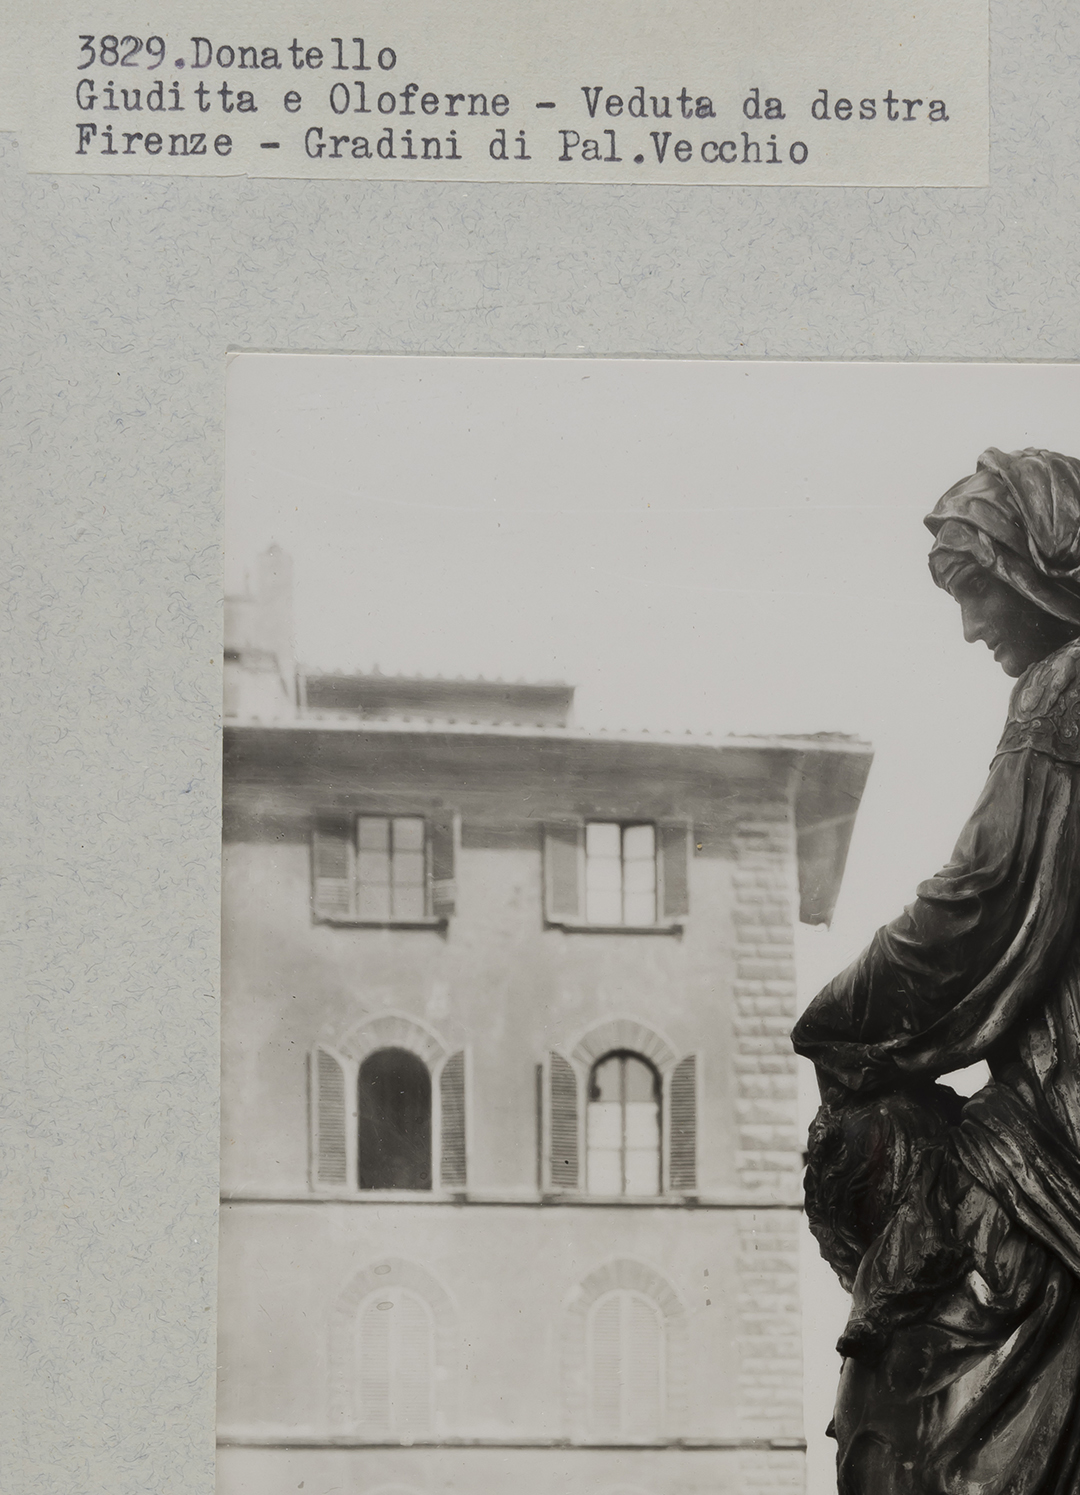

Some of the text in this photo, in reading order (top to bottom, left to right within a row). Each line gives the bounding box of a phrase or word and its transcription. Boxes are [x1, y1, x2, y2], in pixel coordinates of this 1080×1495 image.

[78, 35, 397, 71] 3829.Donatello
[76, 80, 258, 114] Giuditta
[284, 91, 302, 113] e
[329, 81, 510, 117] Oloferne
[581, 86, 717, 120] Veduta
[742, 88, 786, 120] da
[811, 89, 950, 122] destra
[75, 125, 233, 157] Firenze
[304, 127, 463, 160] Gradini
[489, 129, 532, 161] di
[558, 130, 809, 165] Pal.Vecchio
